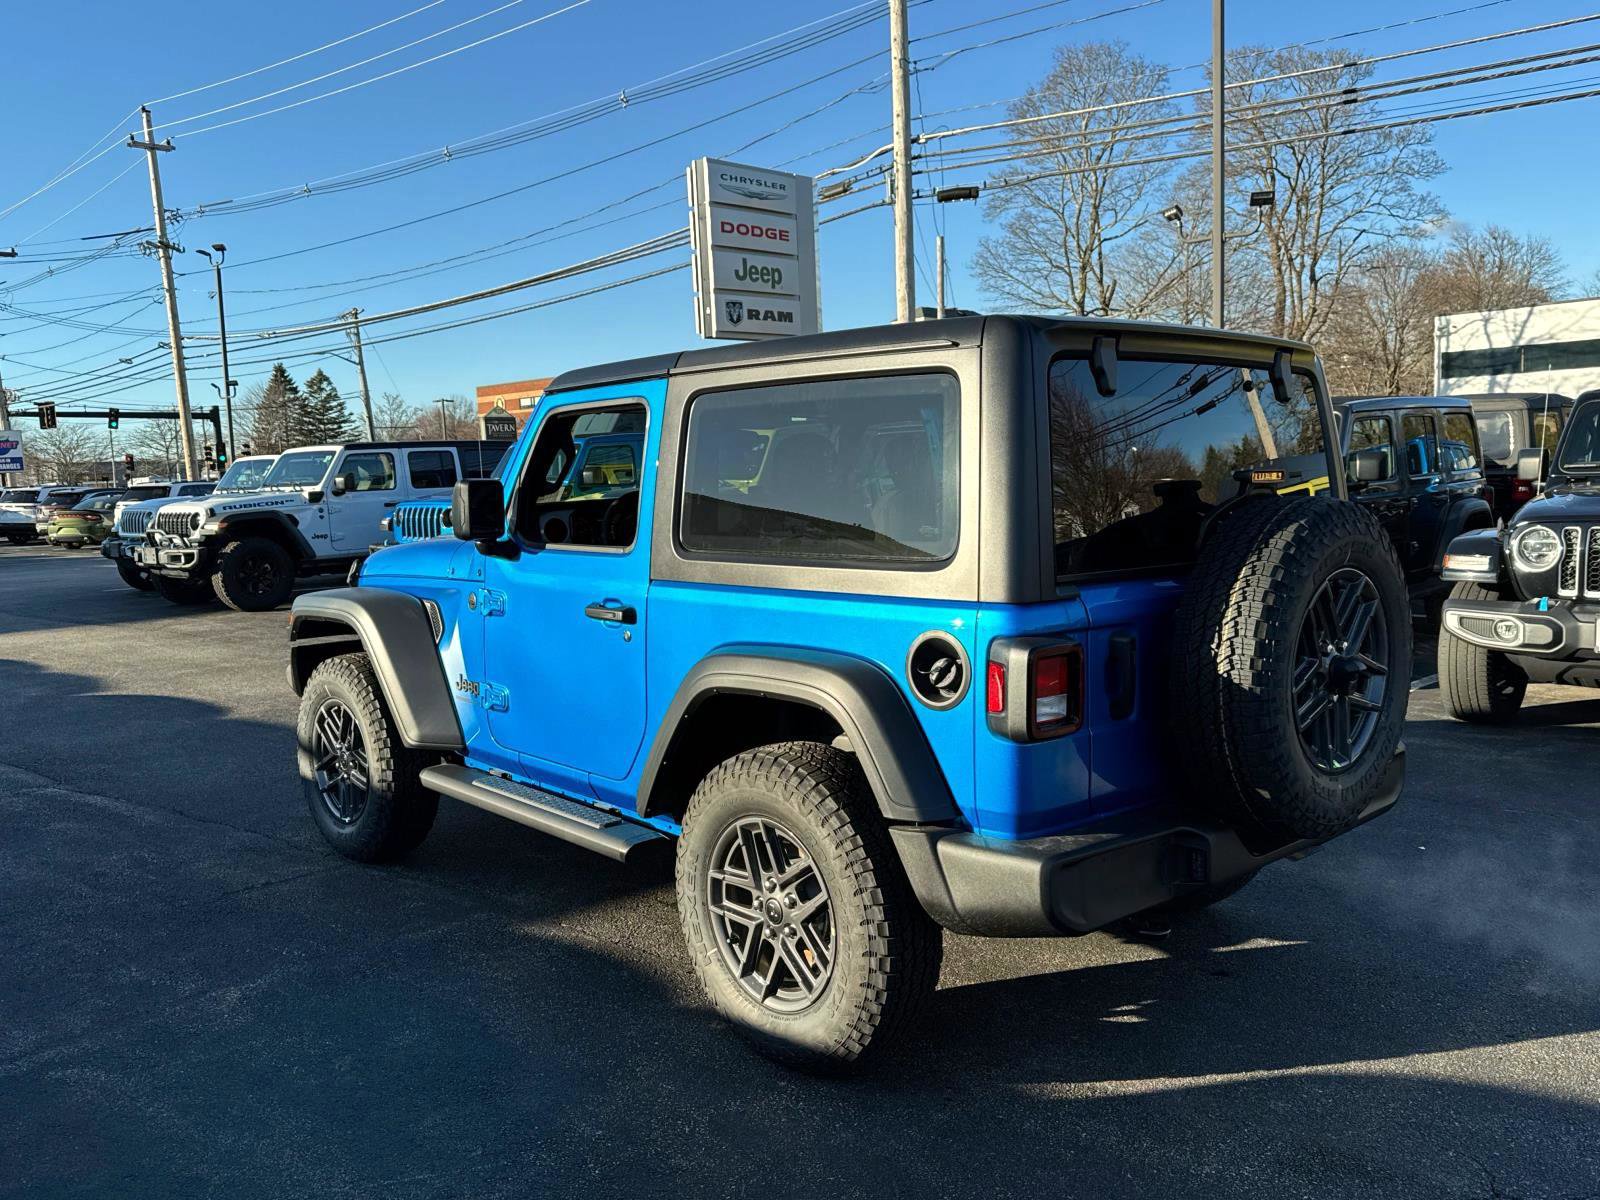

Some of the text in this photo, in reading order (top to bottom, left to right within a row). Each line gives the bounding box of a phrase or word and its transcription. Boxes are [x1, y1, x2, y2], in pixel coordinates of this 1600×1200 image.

[720, 173, 787, 191] CHRYSLER
[720, 221, 790, 242] DODGE
[734, 257, 783, 289] Jeep
[747, 308, 793, 323] RAM
[487, 424, 515, 435] TAVERN
[223, 500, 284, 511] RUBICON
[312, 532, 328, 540] Jeep
[456, 673, 480, 698] Jeep
